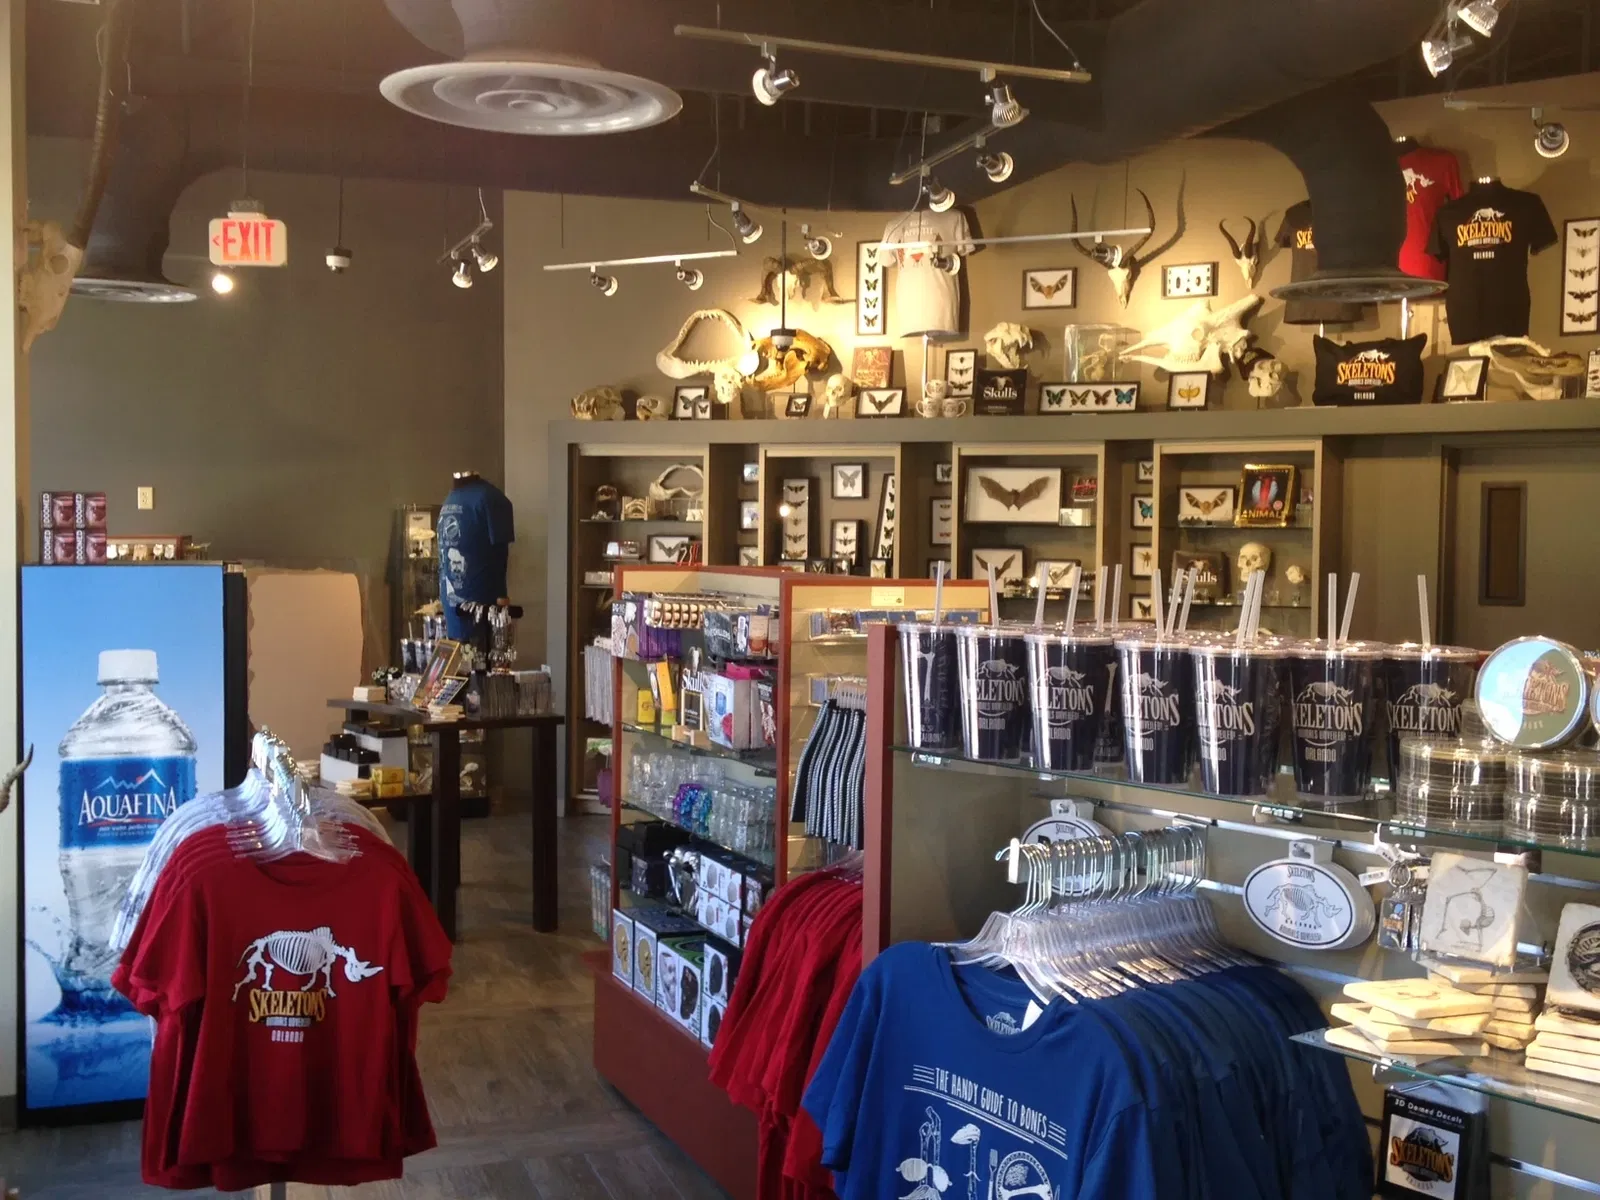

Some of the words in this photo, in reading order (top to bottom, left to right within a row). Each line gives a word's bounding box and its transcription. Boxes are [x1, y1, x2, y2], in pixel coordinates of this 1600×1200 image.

[222, 221, 275, 262] EXIT
[1457, 220, 1512, 248] SKELETONS
[1337, 361, 1396, 385] SKELETONS
[983, 386, 1018, 399] Skulls
[1181, 570, 1218, 583] Sulls
[681, 668, 704, 693] Skull
[1293, 702, 1363, 736] KELETONS
[1386, 701, 1462, 735] SKELETONS
[78, 786, 177, 825] AQUAFINA
[1287, 865, 1316, 883] SKELETONS
[249, 988, 328, 1022] SKELETONS
[936, 1067, 949, 1093] THE
[951, 1073, 979, 1105] HANDY
[980, 1087, 1004, 1117] GUIDE
[1007, 1098, 1018, 1123] TO
[1020, 1104, 1048, 1138] BONES
[1394, 1098, 1406, 1107] 3D
[1407, 1102, 1434, 1116] Domed
[1436, 1110, 1463, 1124] Decals
[1389, 1136, 1455, 1183] SKELETONS
